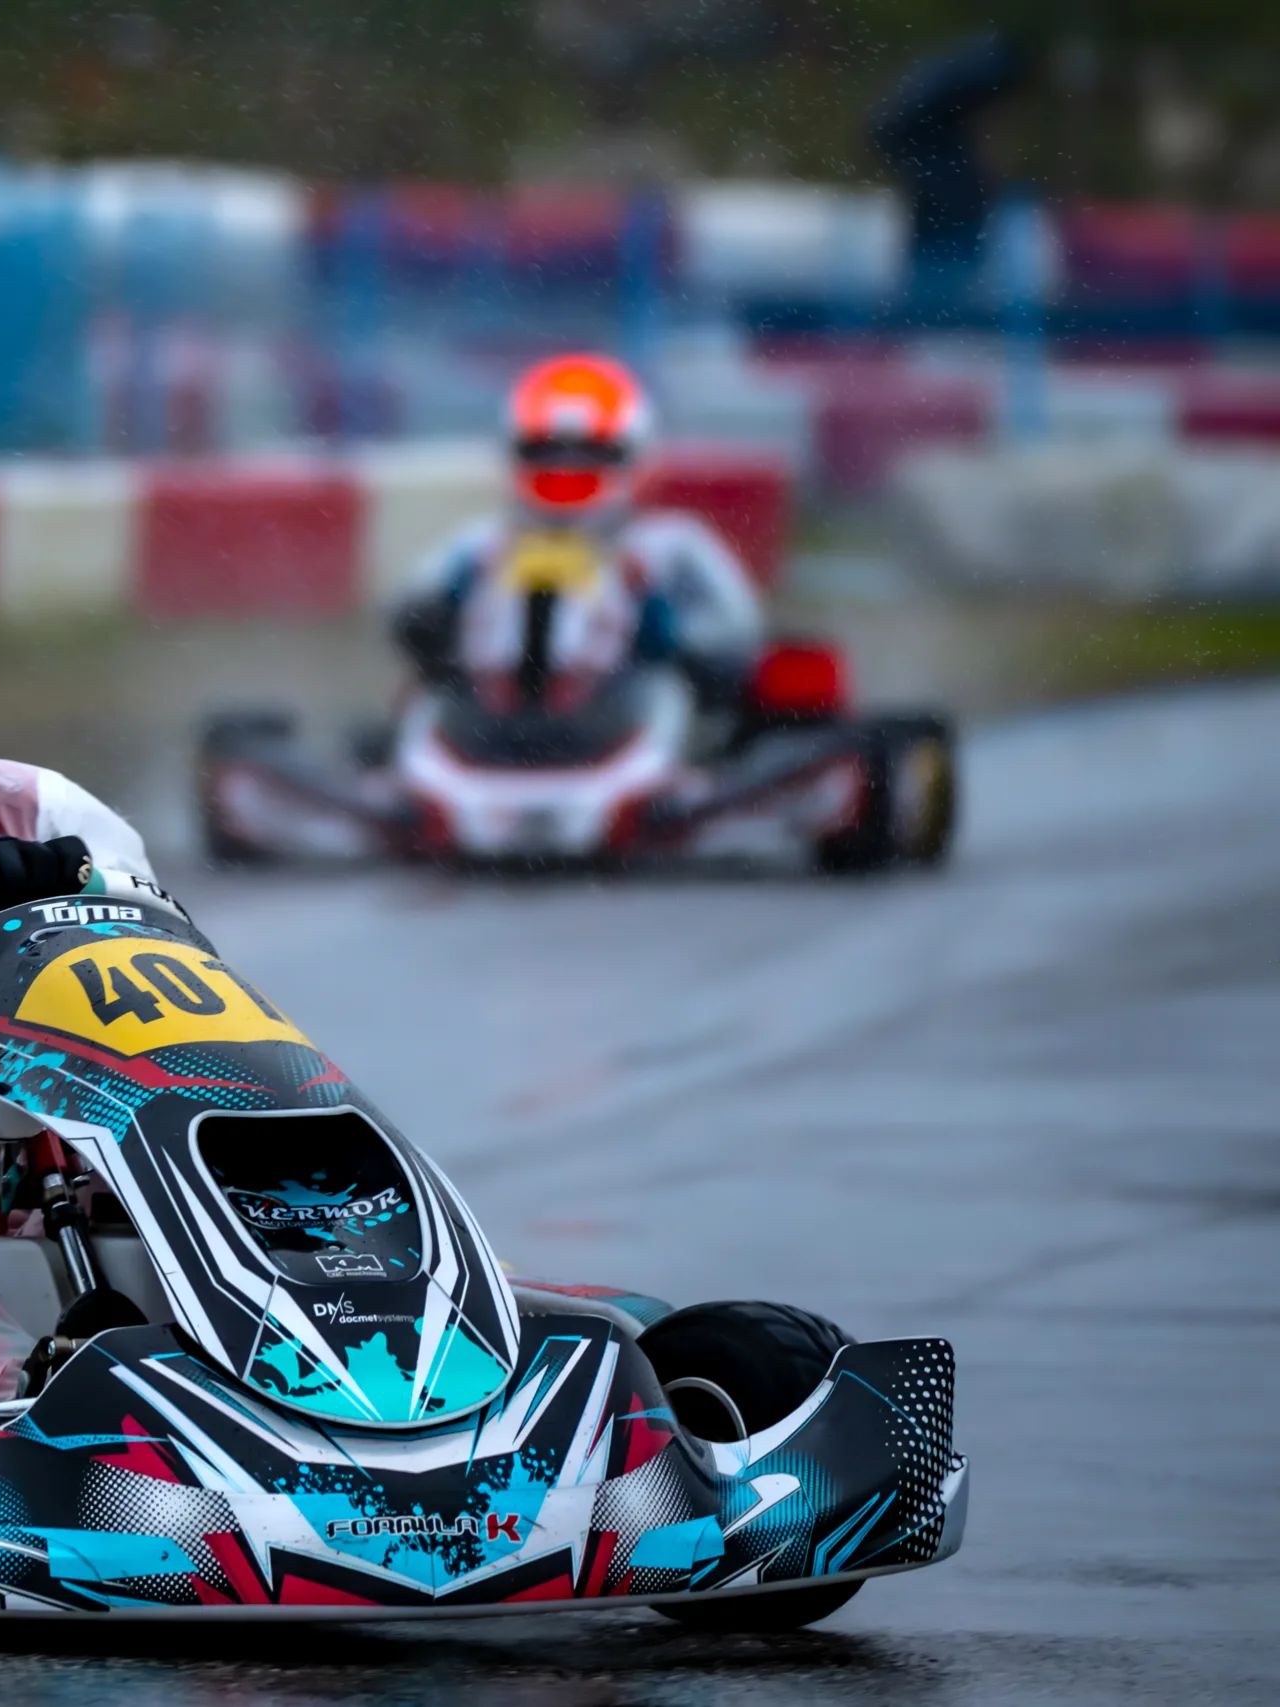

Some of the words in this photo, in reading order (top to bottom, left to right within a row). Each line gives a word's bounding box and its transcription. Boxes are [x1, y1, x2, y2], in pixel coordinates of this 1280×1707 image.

[69, 952, 289, 1027] 401
[242, 1187, 402, 1221] KERMOR
[326, 1515, 479, 1539] FORMULA
[486, 1512, 521, 1543] K
